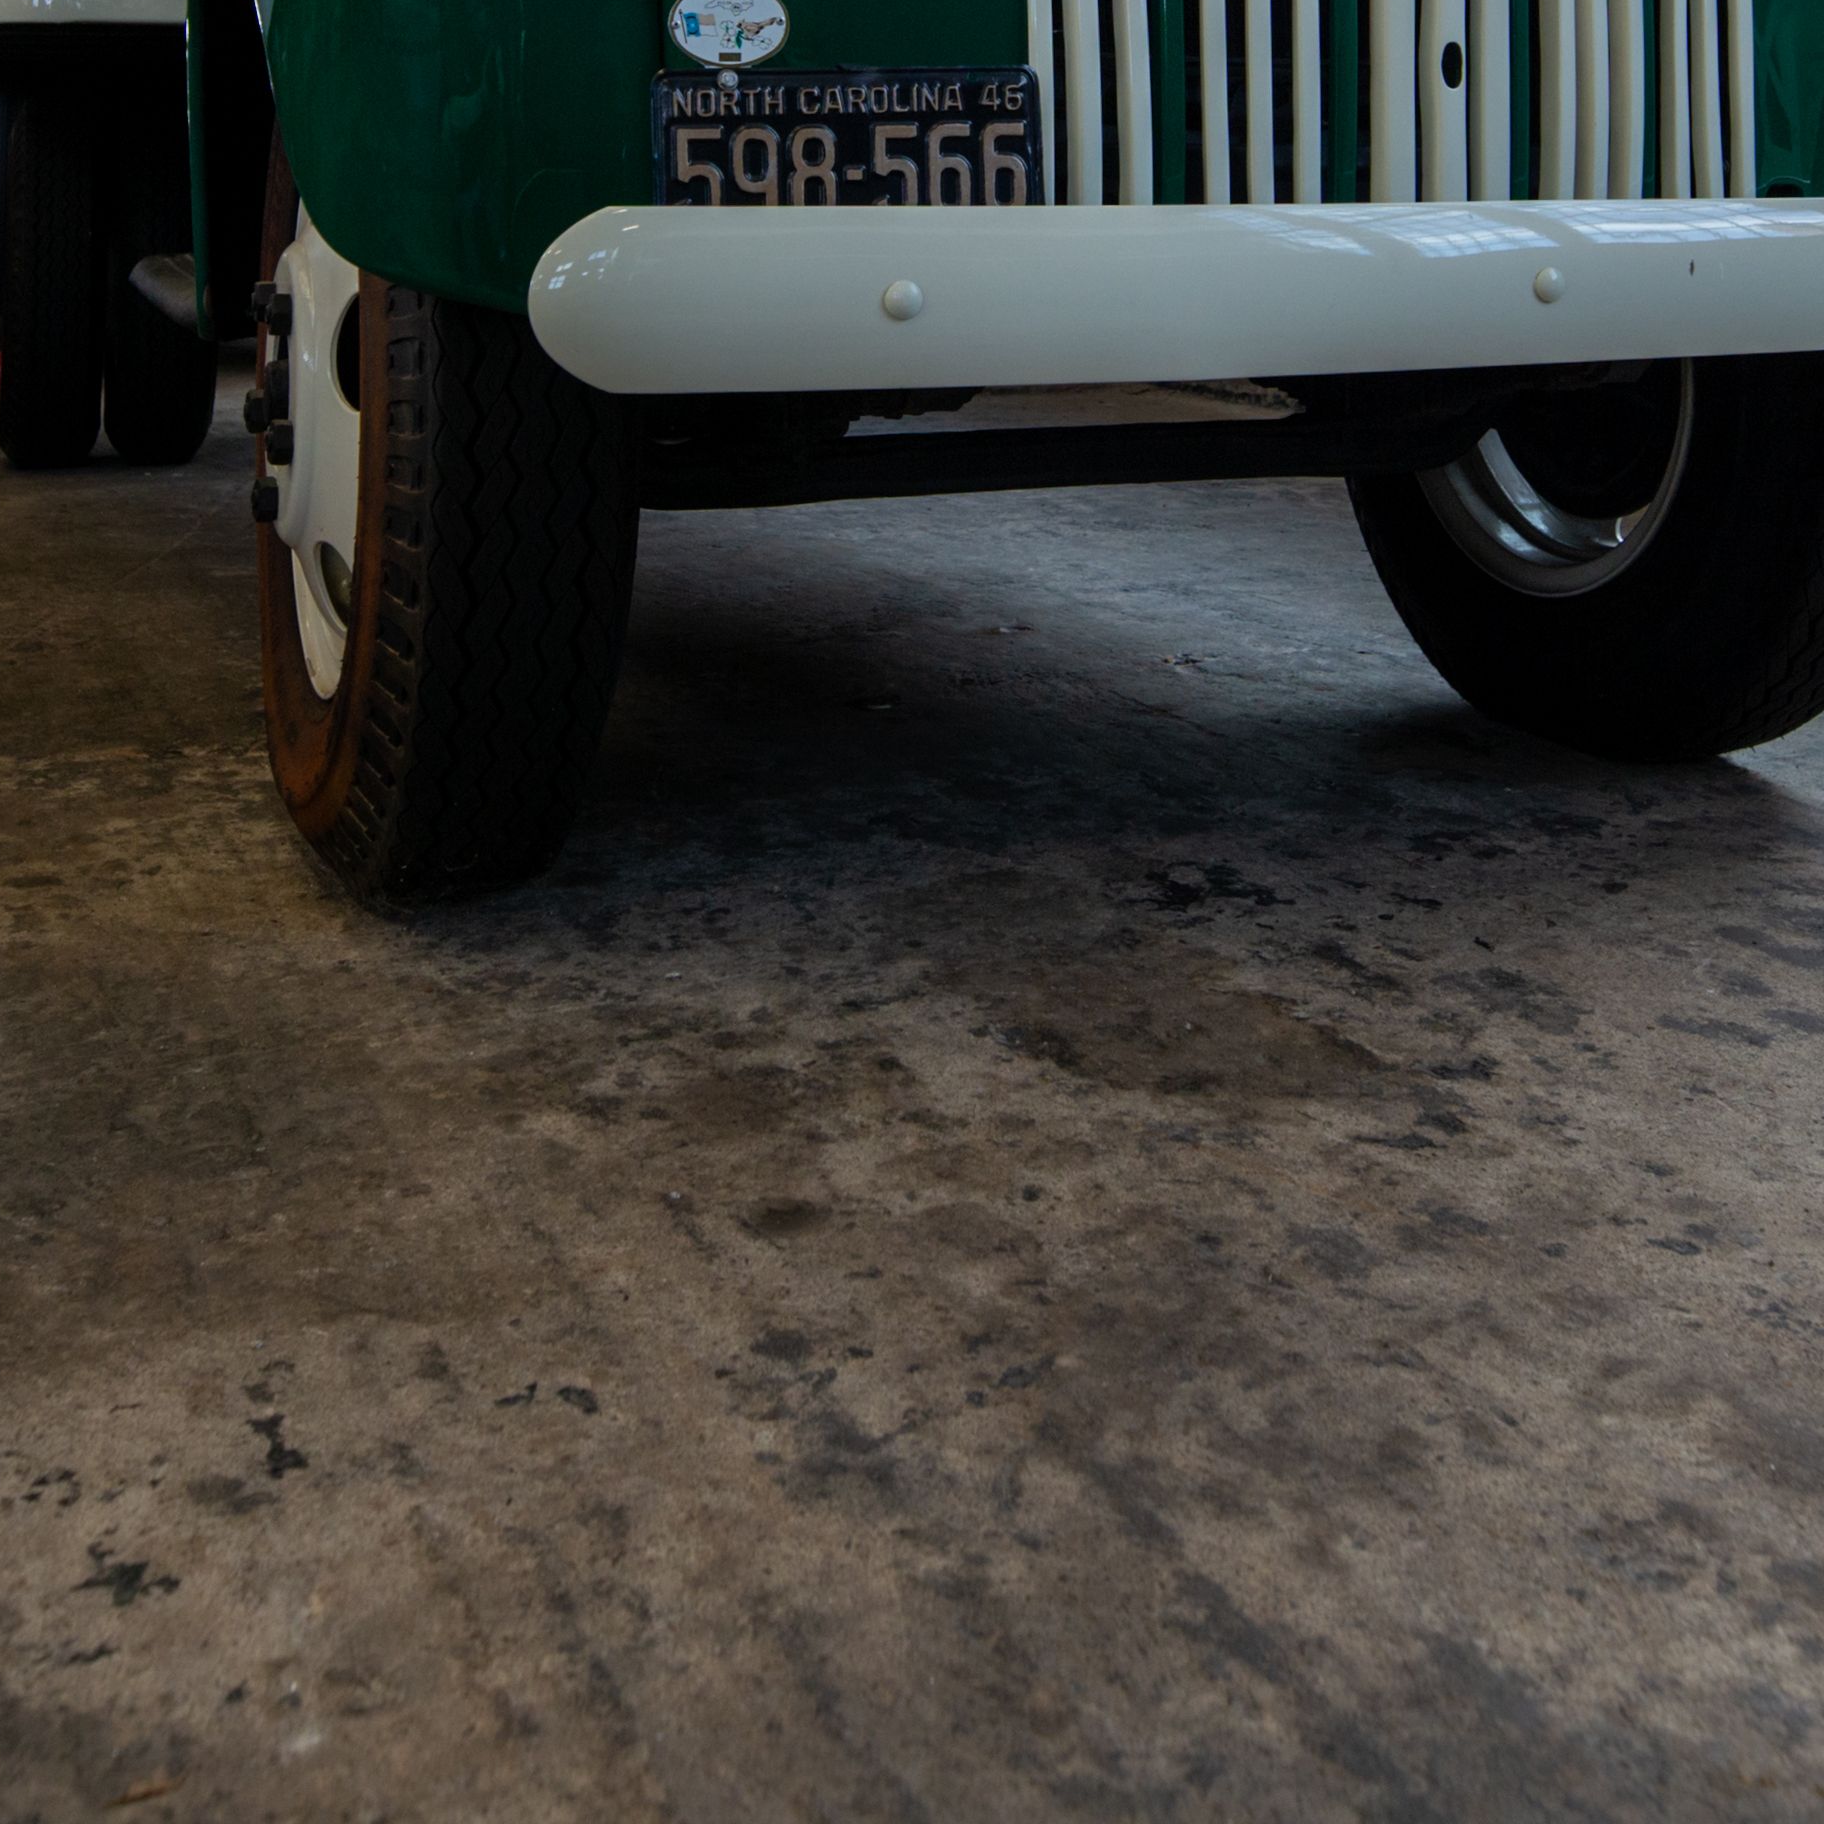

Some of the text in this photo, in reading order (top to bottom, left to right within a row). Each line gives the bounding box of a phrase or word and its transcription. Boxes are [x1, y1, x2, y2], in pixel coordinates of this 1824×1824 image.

[671, 82, 1026, 118] NORTH CAROLINA 46
[674, 121, 1028, 206] 598-566
